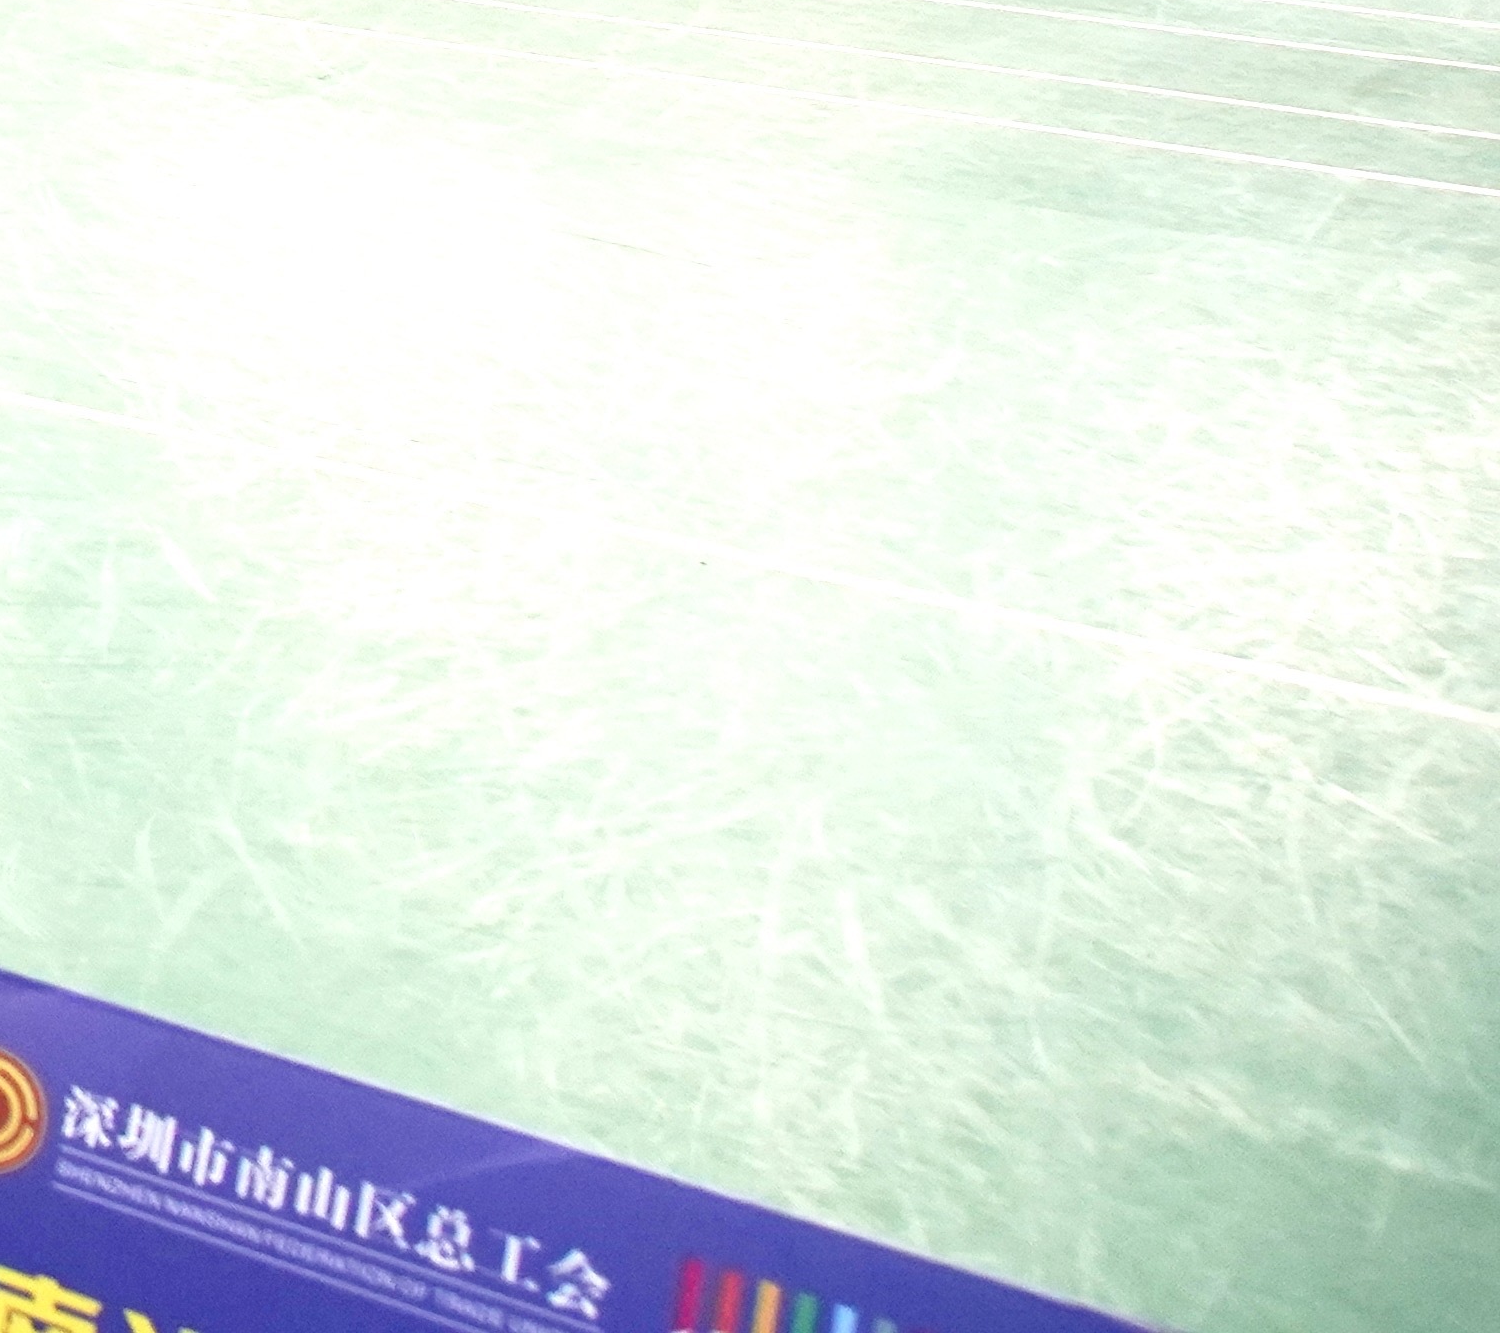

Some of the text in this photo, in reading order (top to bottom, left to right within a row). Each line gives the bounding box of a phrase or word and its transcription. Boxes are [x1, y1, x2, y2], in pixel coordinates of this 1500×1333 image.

[61, 1084, 612, 1321] 深圳市南山区总工会
